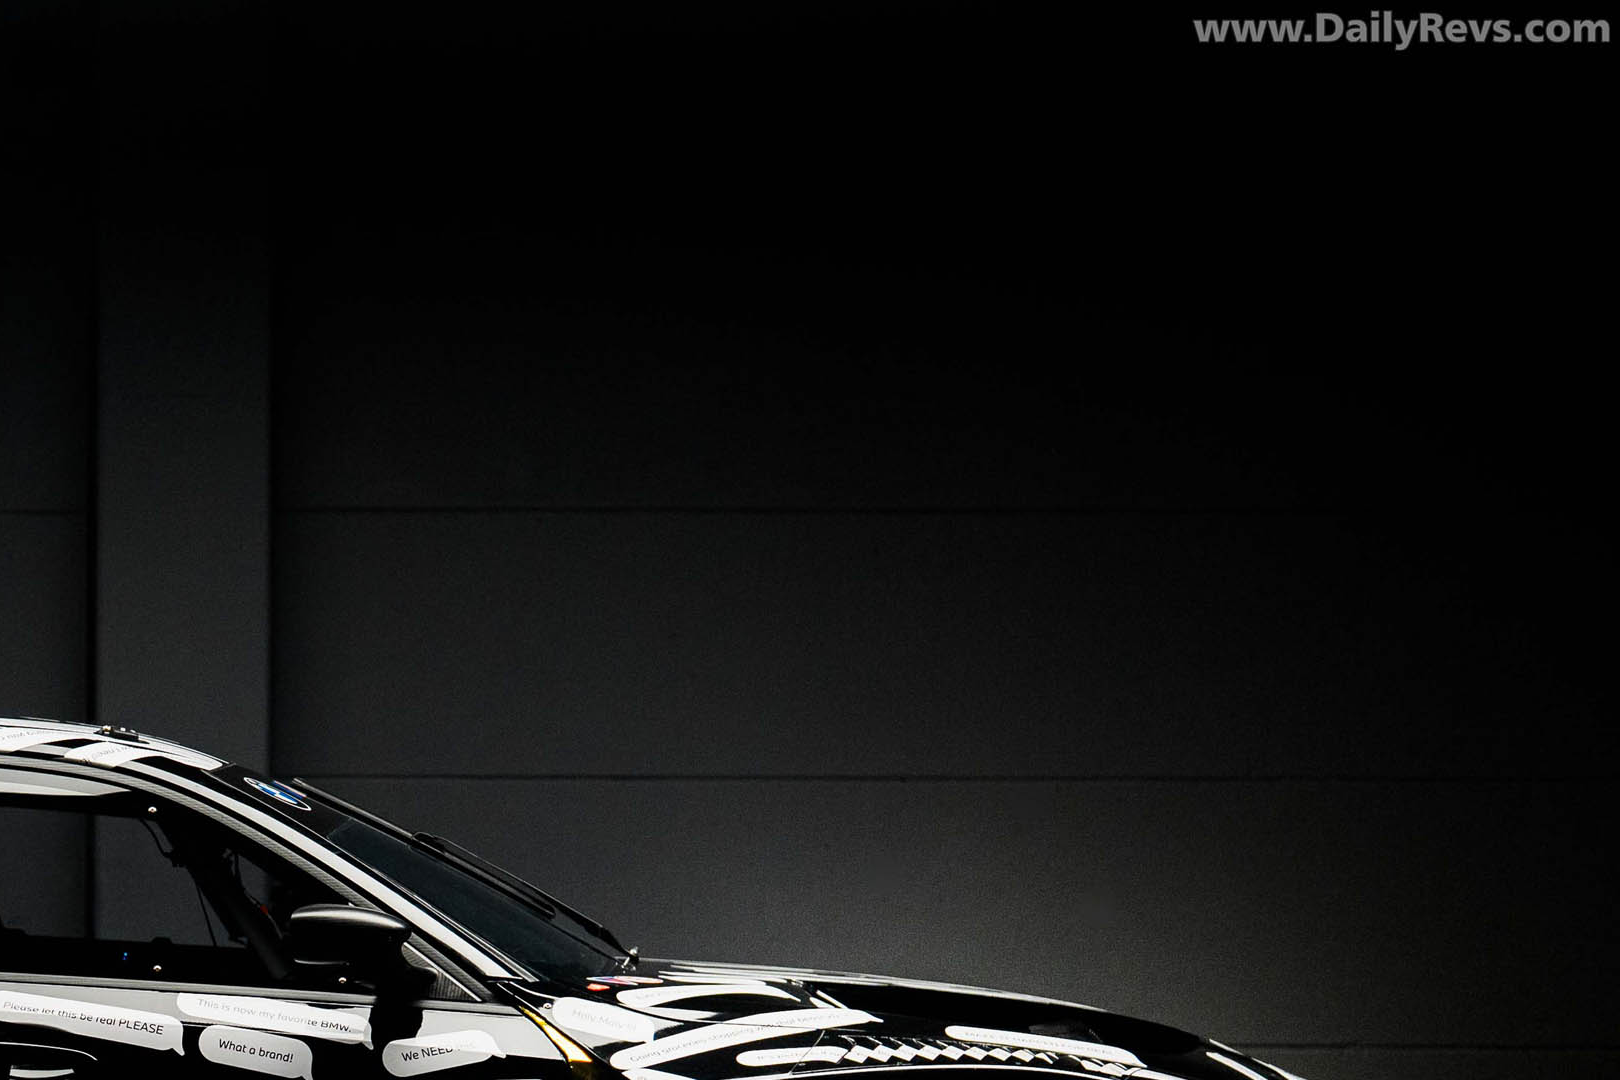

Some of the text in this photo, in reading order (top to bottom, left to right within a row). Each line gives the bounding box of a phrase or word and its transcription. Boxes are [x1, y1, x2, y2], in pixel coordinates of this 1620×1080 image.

[79, 1012, 94, 1022] be
[118, 1019, 165, 1035] PLEASE
[219, 1038, 294, 1063] What a brand!
[401, 1051, 419, 1062] We
